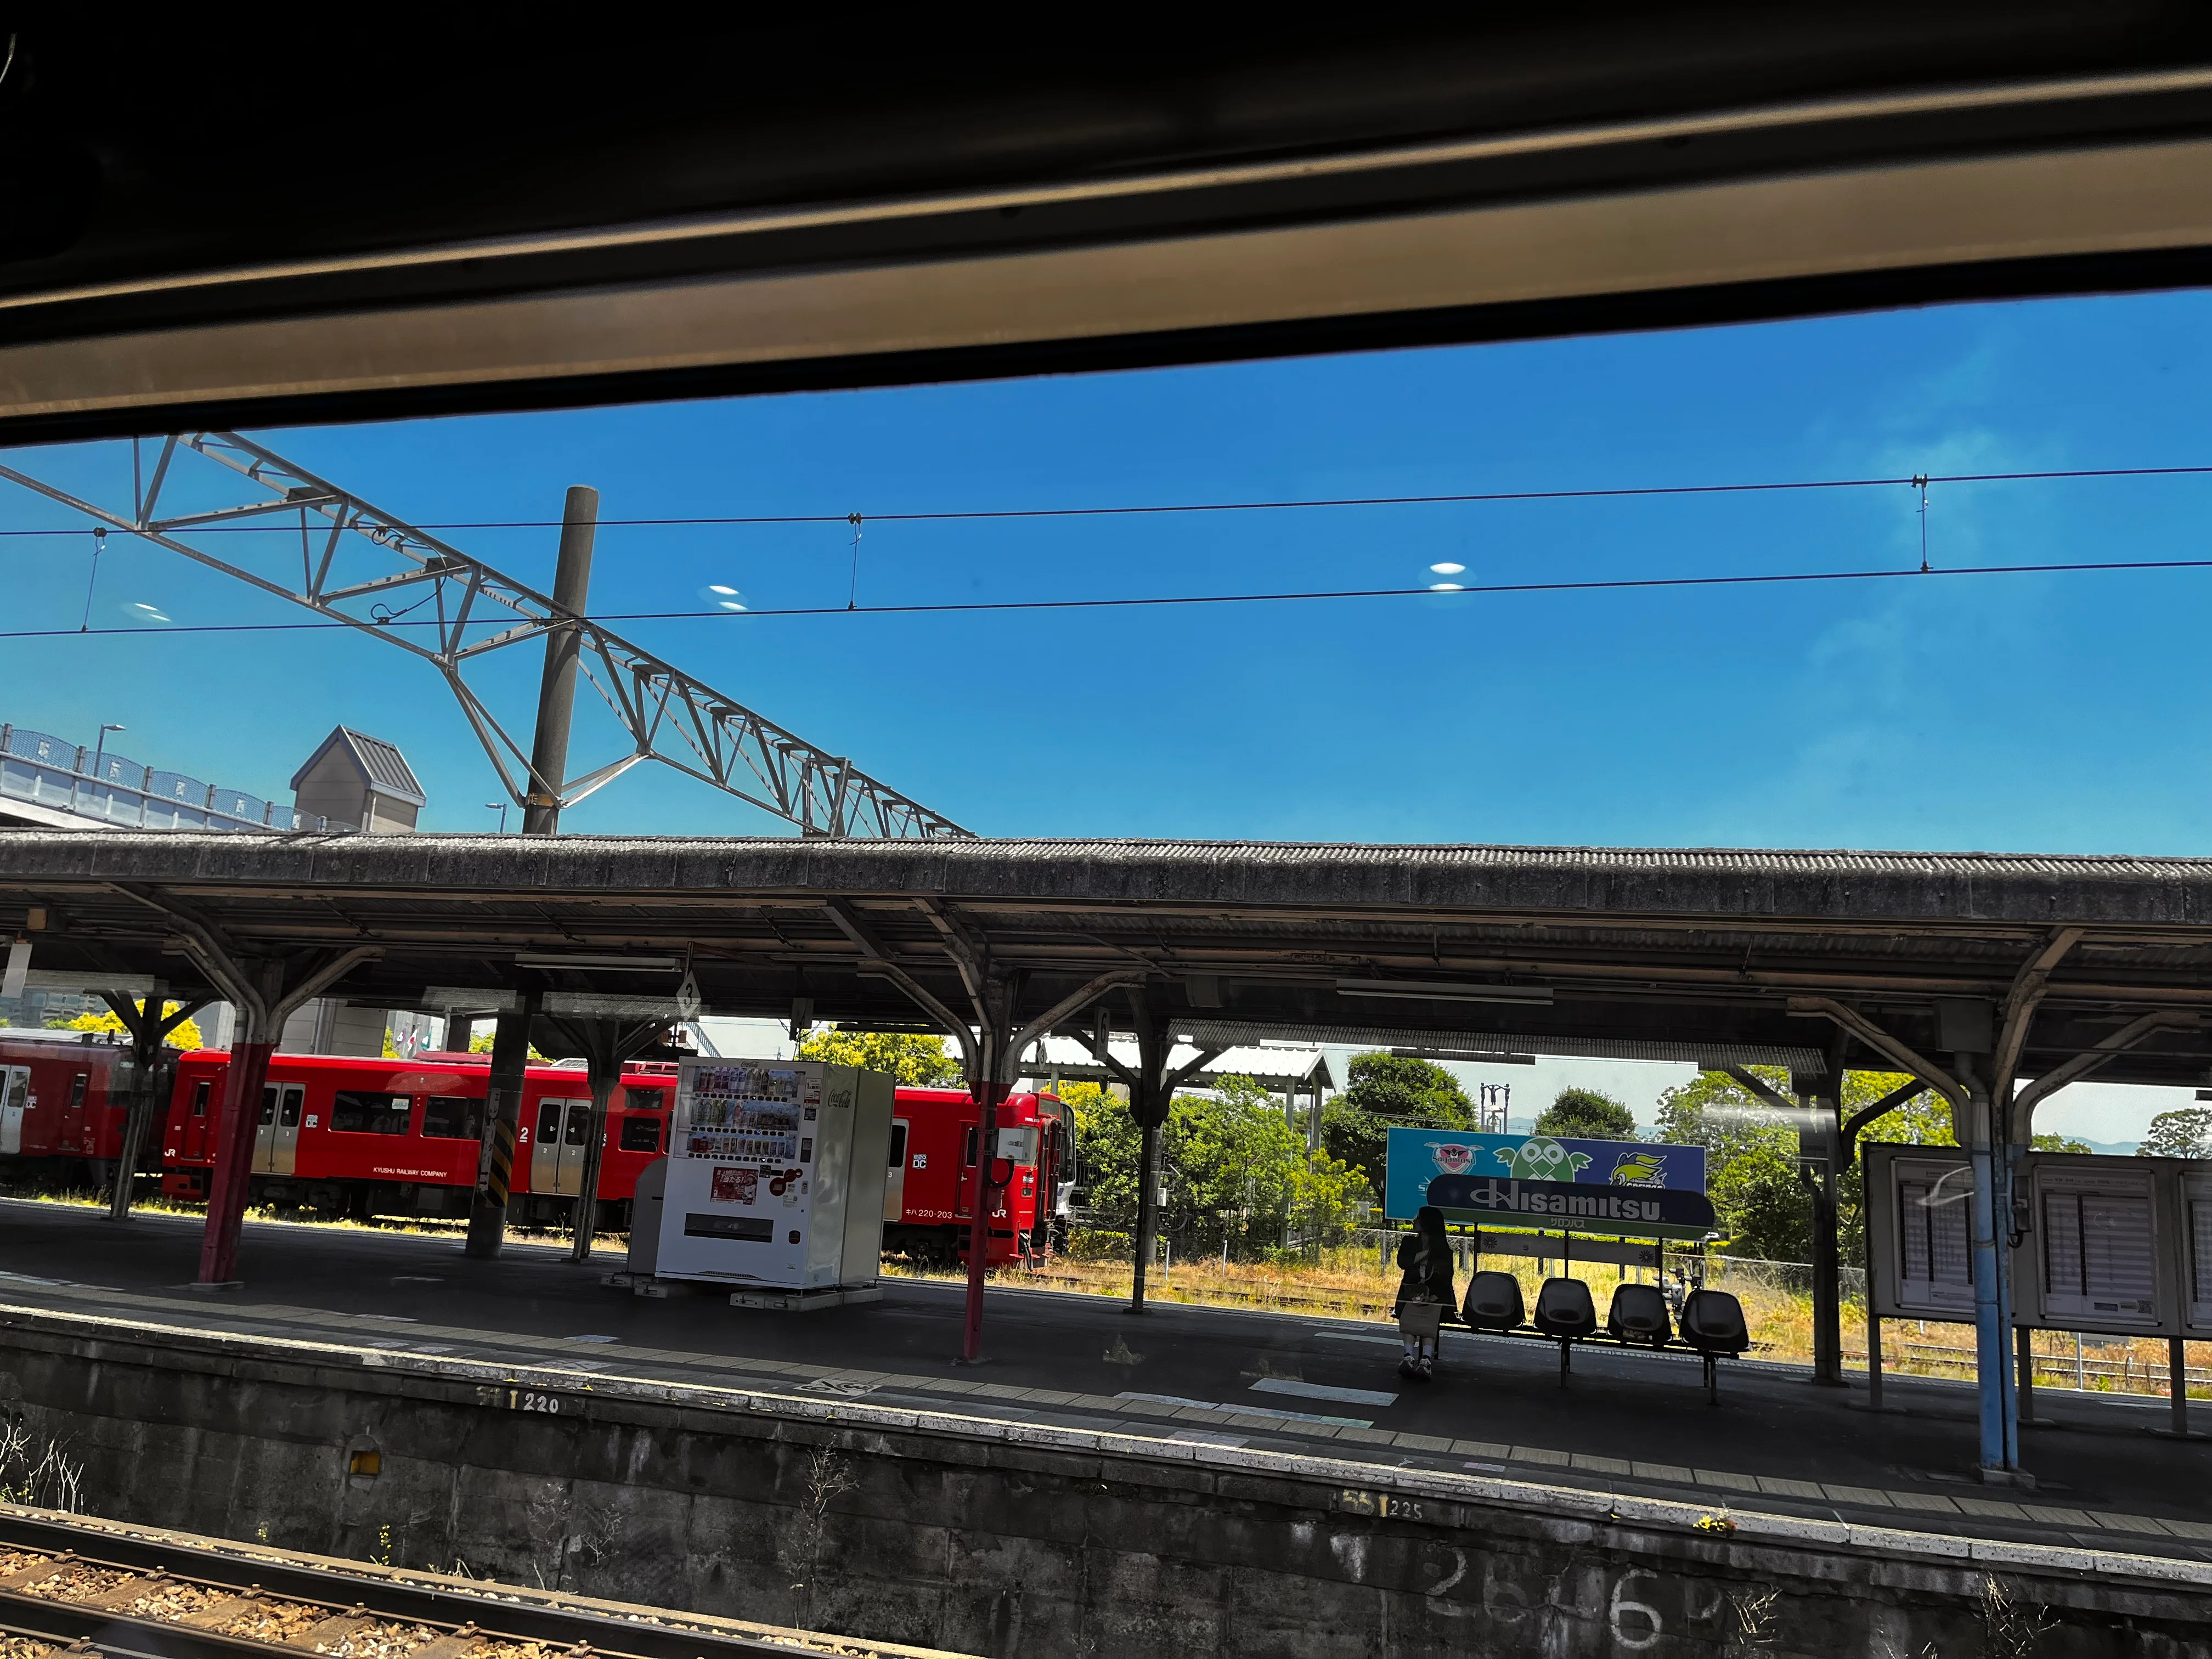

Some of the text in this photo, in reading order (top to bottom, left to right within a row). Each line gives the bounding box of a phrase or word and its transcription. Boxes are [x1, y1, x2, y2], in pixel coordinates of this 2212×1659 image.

[684, 983, 693, 1006] 3
[1101, 1012, 1107, 1043] 6
[1040, 1049, 1045, 1064] 3
[520, 1127, 529, 1139] 2
[164, 1149, 176, 1157] JR
[913, 1160, 927, 1168] DC
[1470, 1179, 1660, 1221] Hisamitsu
[918, 1209, 952, 1219] 220-203
[991, 1209, 1007, 1218] JR
[1550, 1217, 1585, 1229] サロンパス
[523, 1393, 558, 1414] 220
[1390, 1500, 1423, 1520] 225
